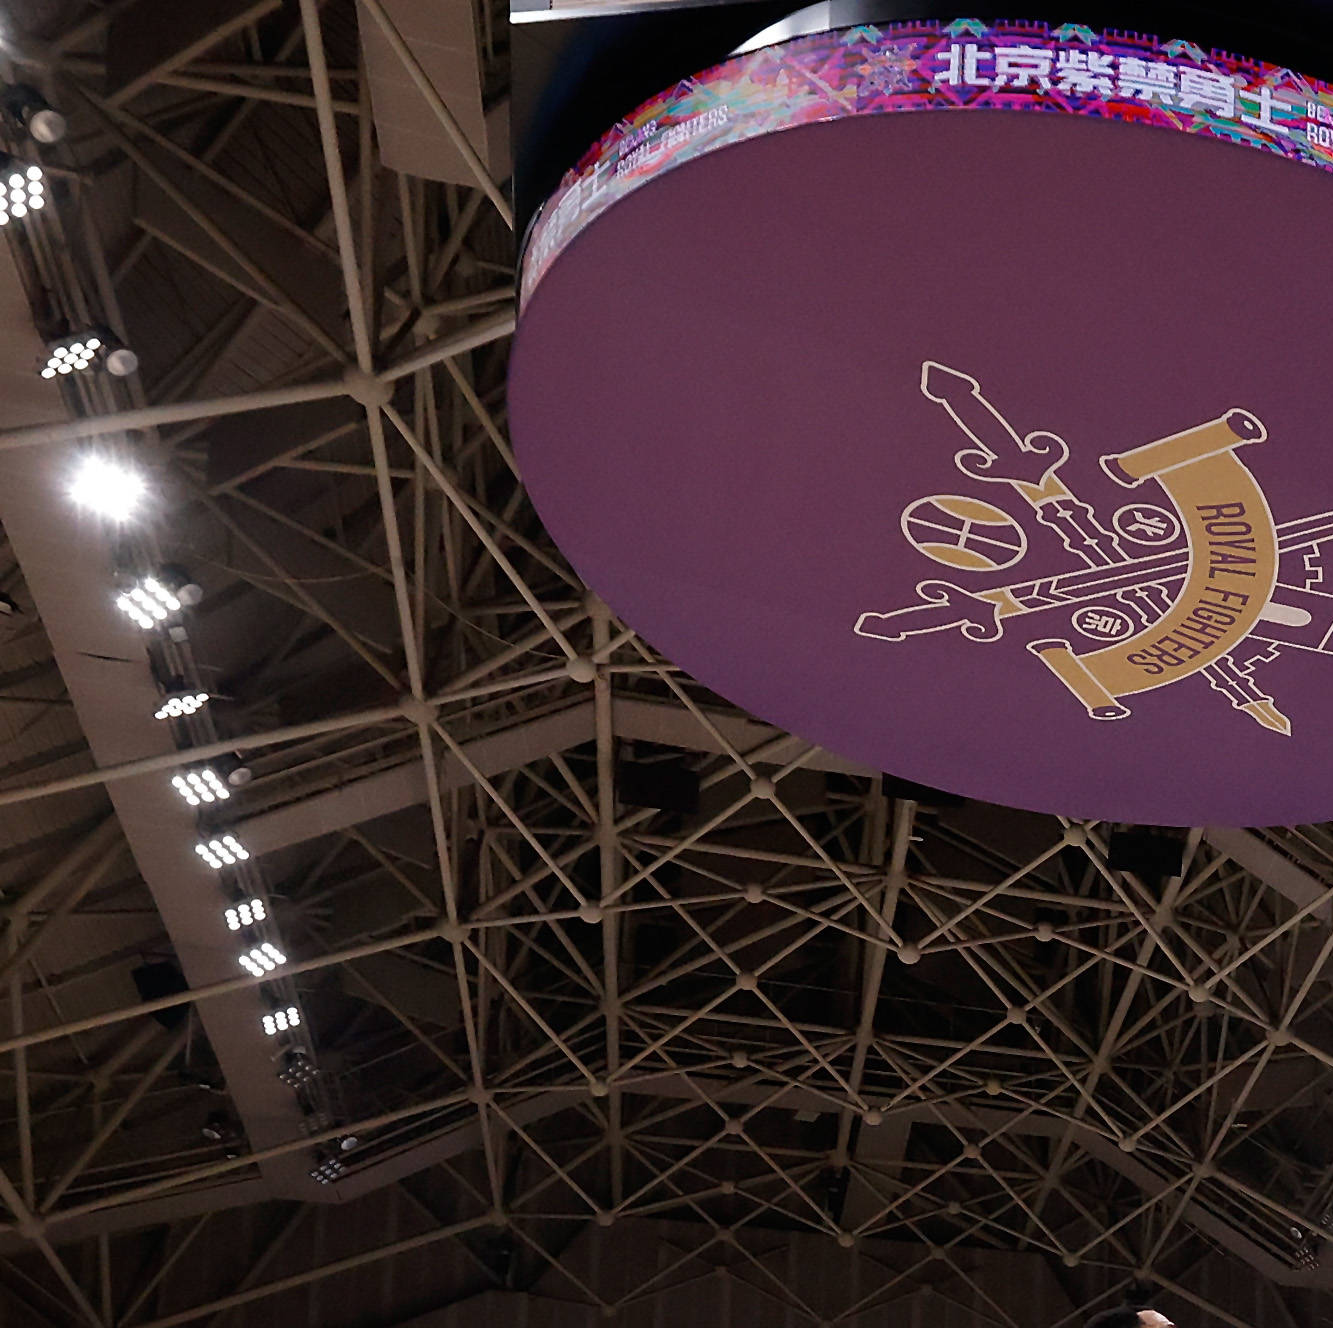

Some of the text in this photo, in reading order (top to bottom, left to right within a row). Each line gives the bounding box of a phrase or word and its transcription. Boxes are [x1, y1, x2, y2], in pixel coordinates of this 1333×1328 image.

[933, 43, 1292, 135] 北京紫禁勇士
[1125, 501, 1256, 676] ROYAL FIGHTERS
